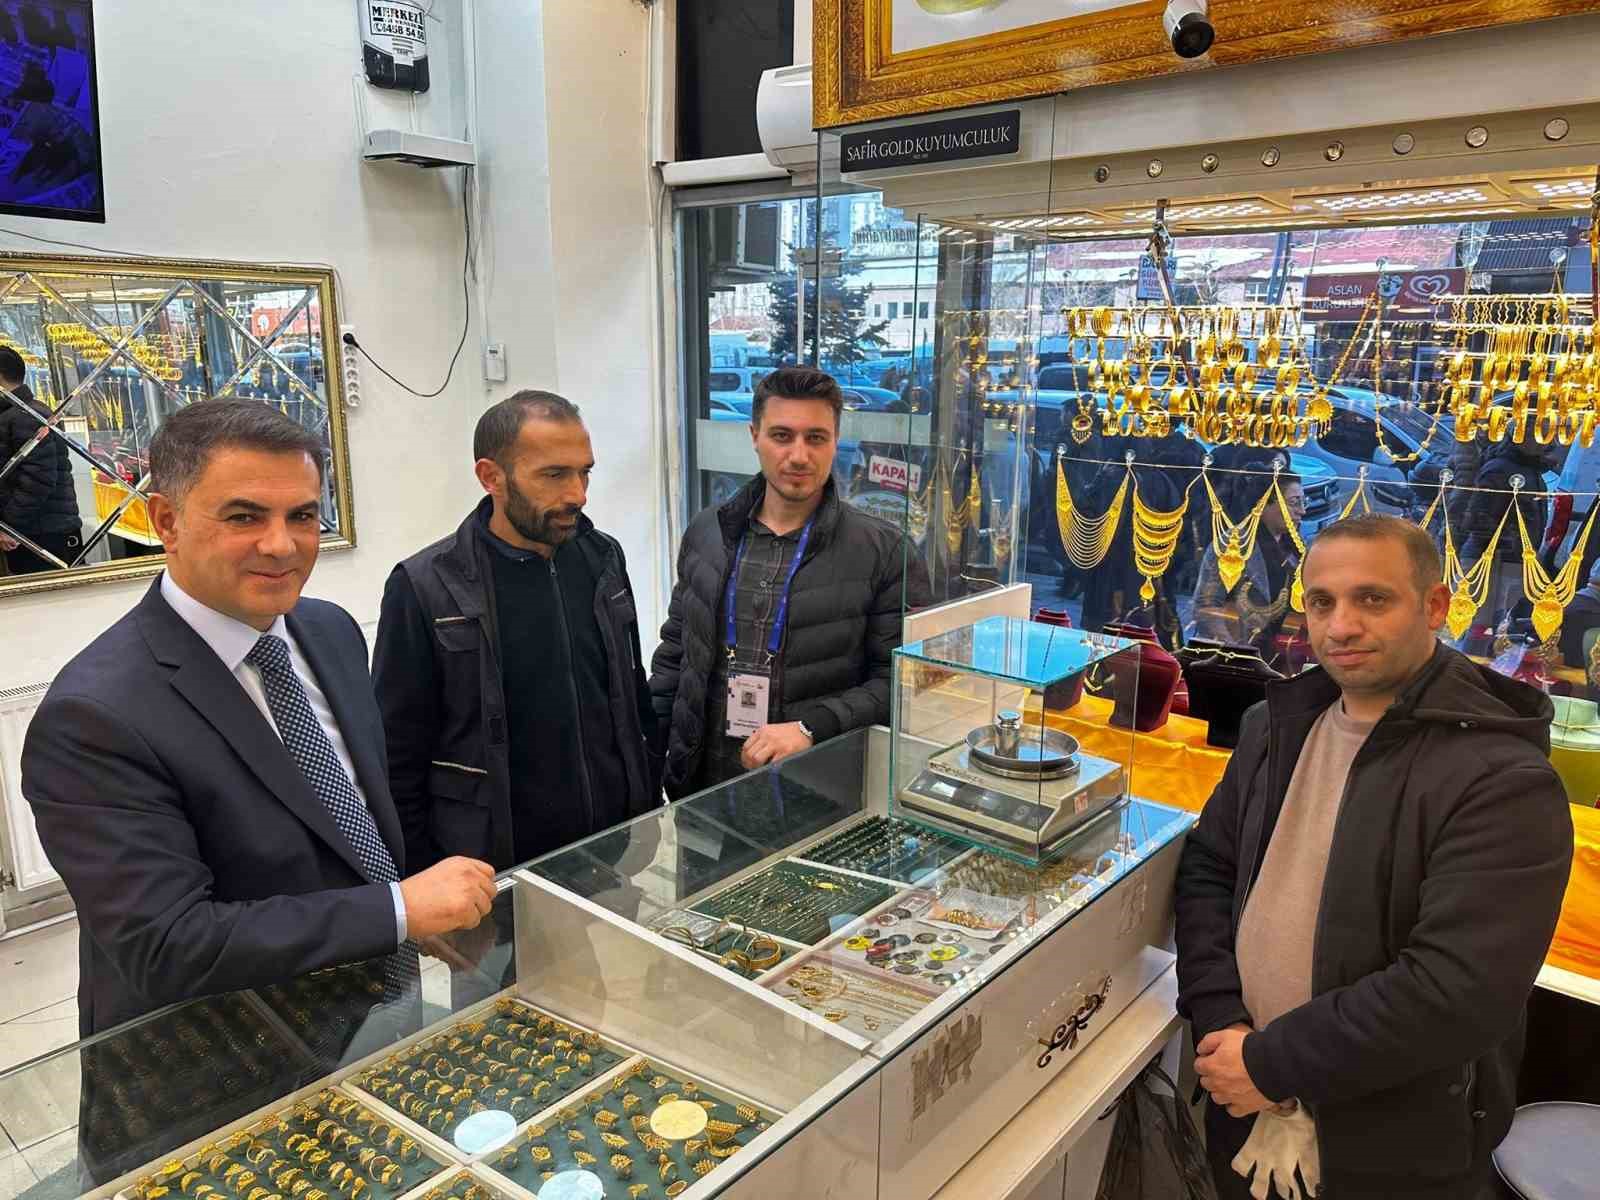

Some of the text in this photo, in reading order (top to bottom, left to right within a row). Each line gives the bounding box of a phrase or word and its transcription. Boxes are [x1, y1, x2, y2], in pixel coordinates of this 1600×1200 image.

[847, 126, 1010, 161] SAFİR GOLD KUYUMCULUK
[1327, 284, 1362, 296] ASLAN
[872, 462, 918, 485] KAPAI
